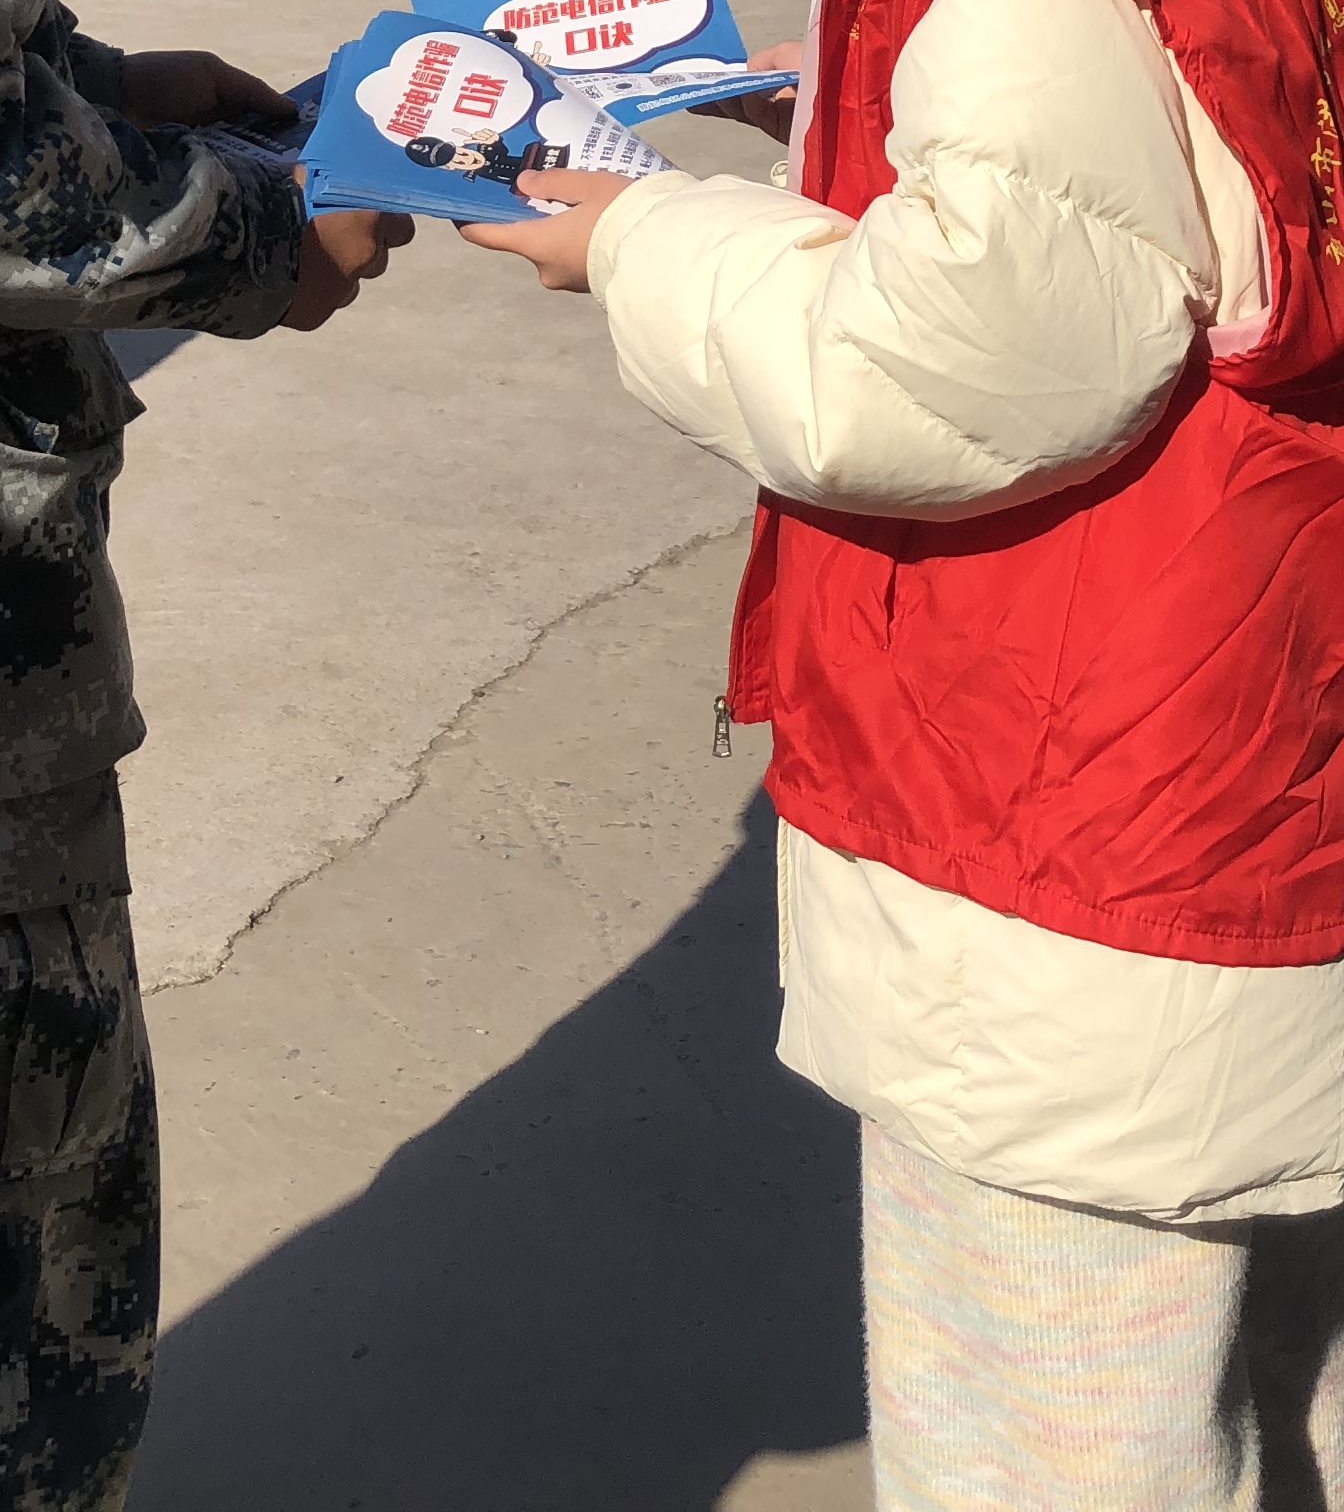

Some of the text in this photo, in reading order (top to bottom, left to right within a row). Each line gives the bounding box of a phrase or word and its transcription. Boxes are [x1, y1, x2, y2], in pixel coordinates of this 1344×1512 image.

[564, 20, 634, 56] 口诀
[385, 39, 461, 140] 防范电信诈骗
[452, 72, 509, 120] 口诀
